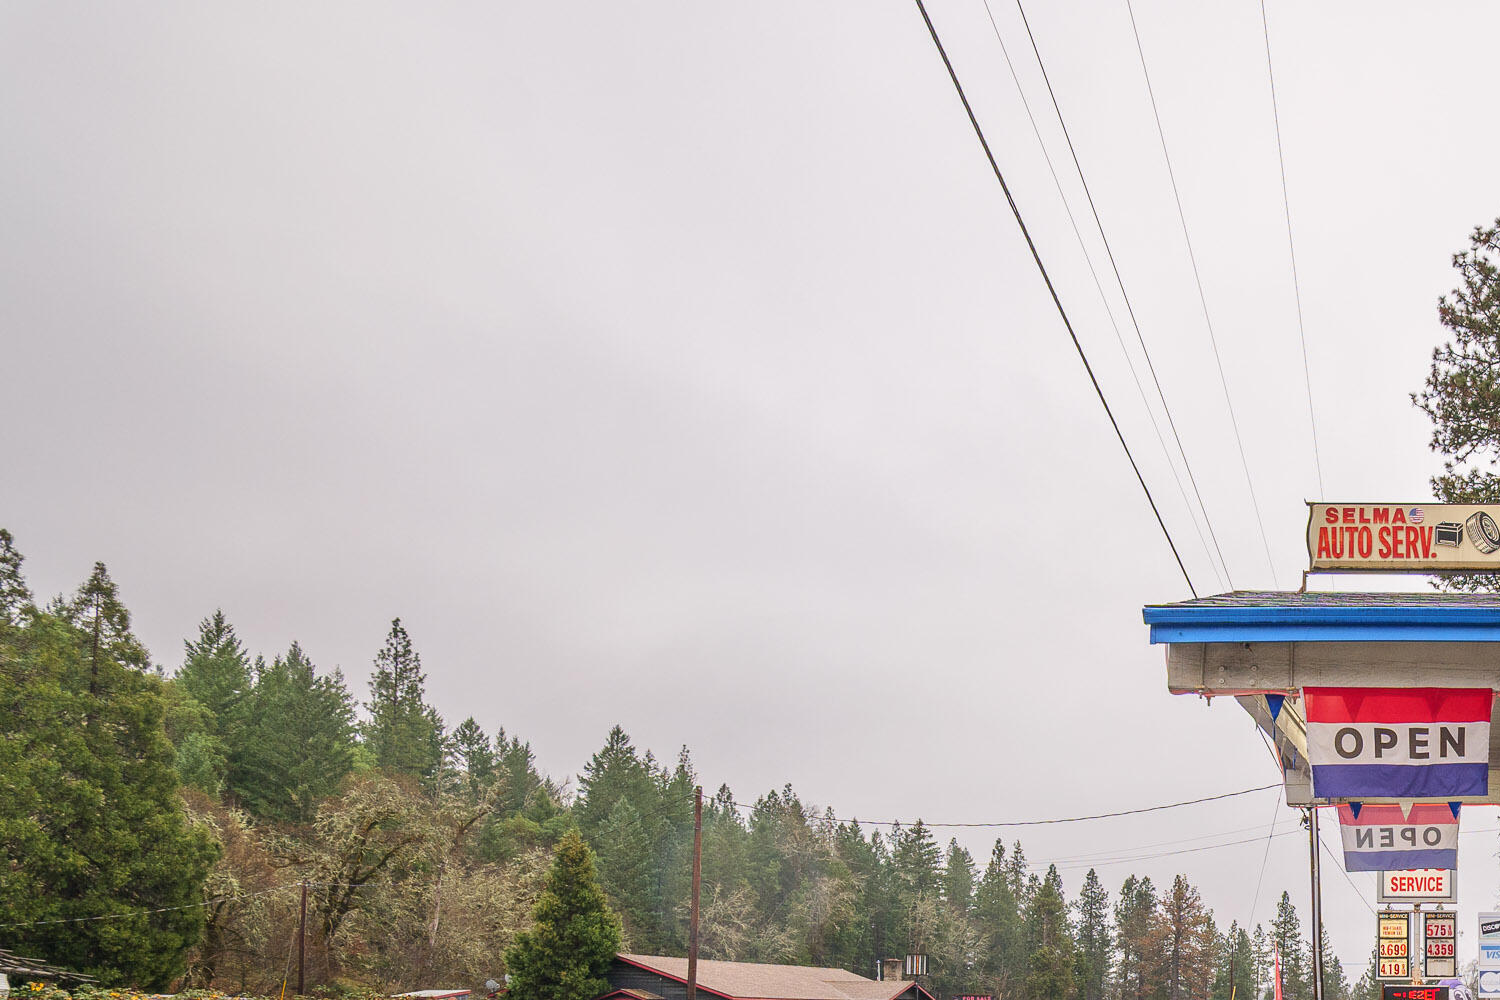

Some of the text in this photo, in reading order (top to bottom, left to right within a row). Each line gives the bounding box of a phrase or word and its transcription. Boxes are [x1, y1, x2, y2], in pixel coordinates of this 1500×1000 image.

[1325, 507, 1407, 524] SELMA
[1317, 526, 1437, 559] AUTO SERV.
[1334, 727, 1466, 760] OPEN
[1390, 876, 1443, 892] SERVICE
